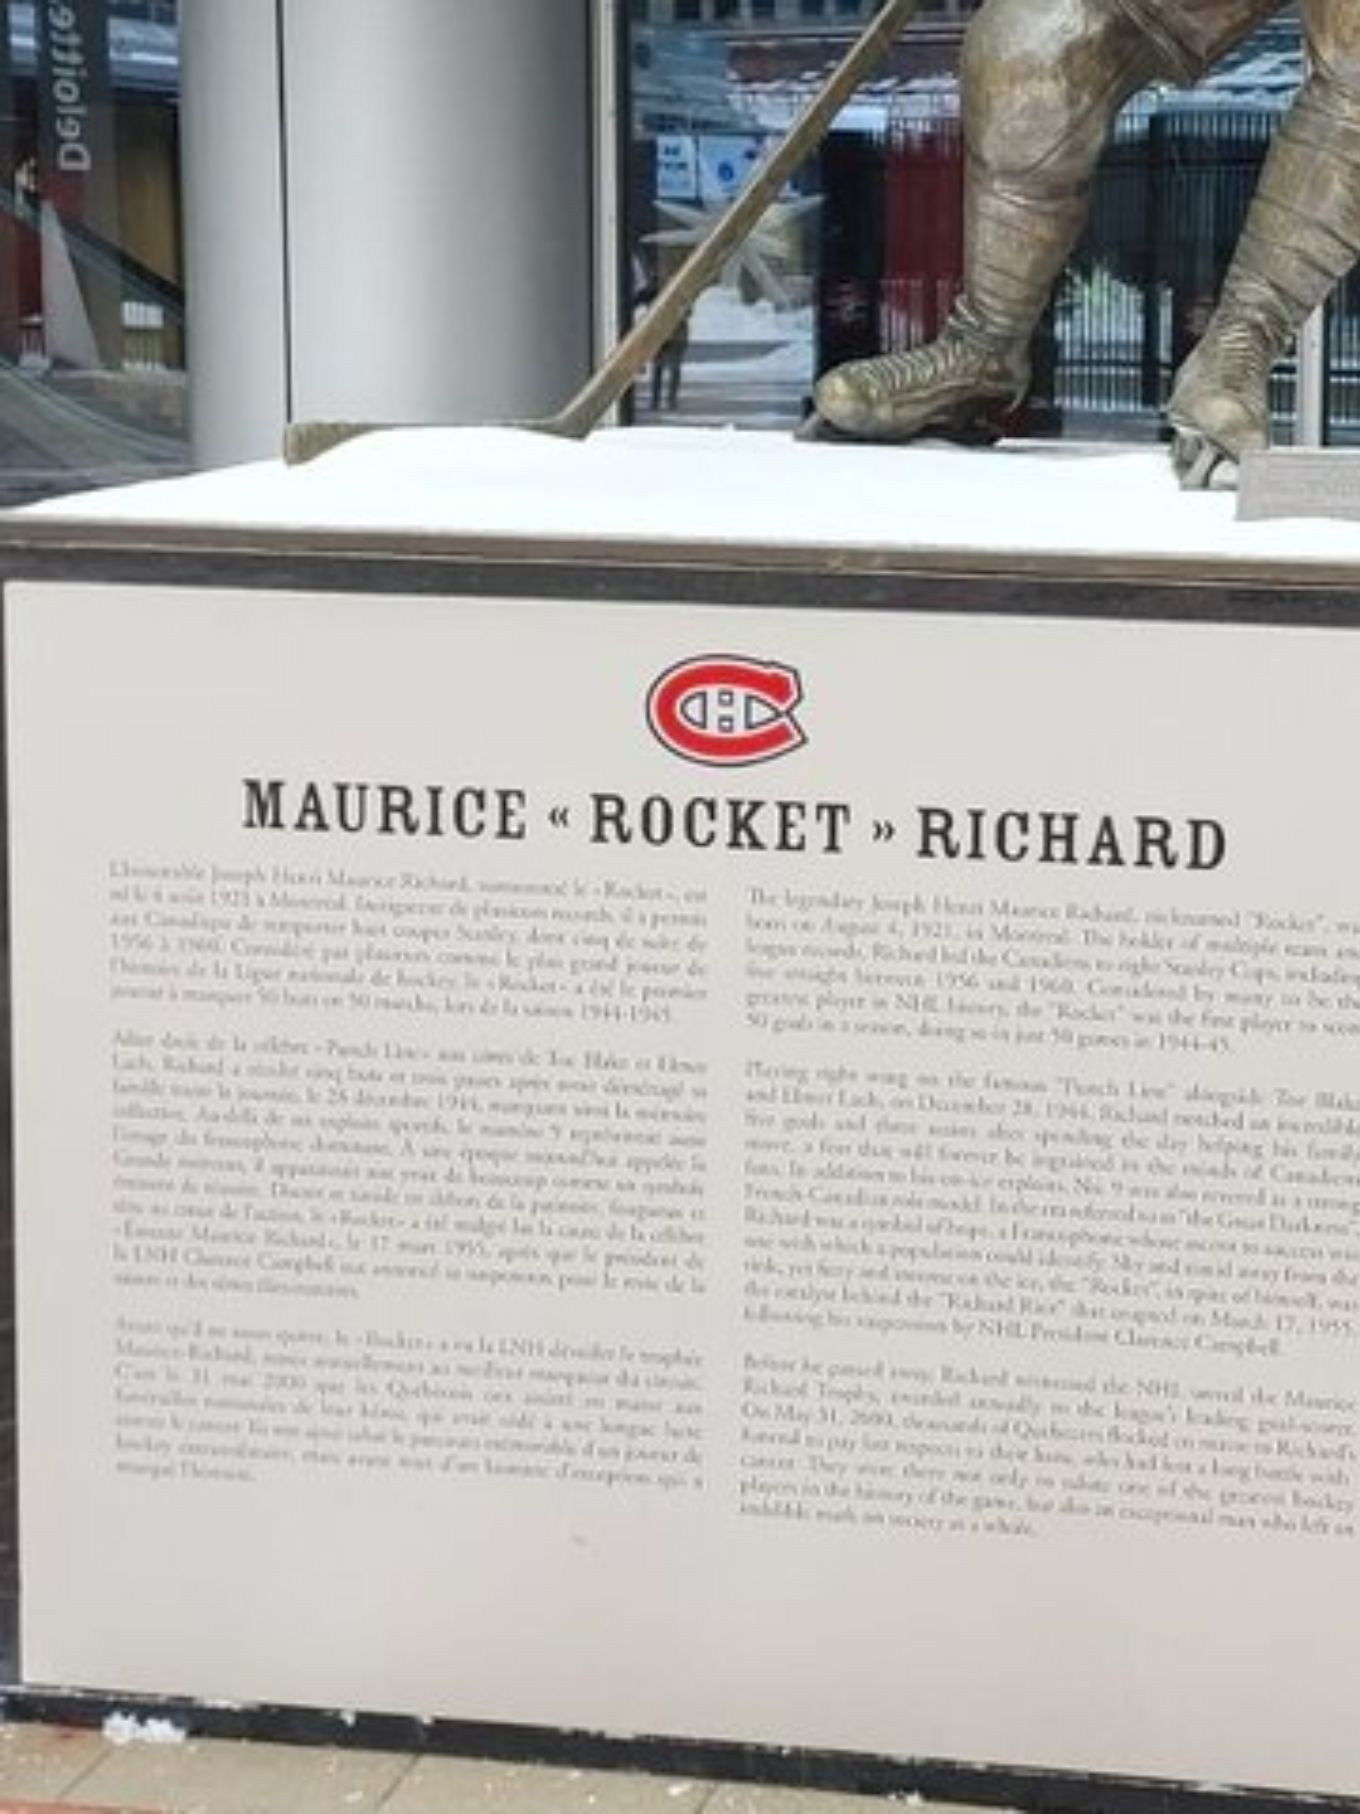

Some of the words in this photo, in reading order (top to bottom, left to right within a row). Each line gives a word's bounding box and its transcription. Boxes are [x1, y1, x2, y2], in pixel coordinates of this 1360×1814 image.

[242, 778, 526, 839] MAURICE
[590, 791, 851, 854] ROCKET
[916, 806, 1226, 871] RICHARD
